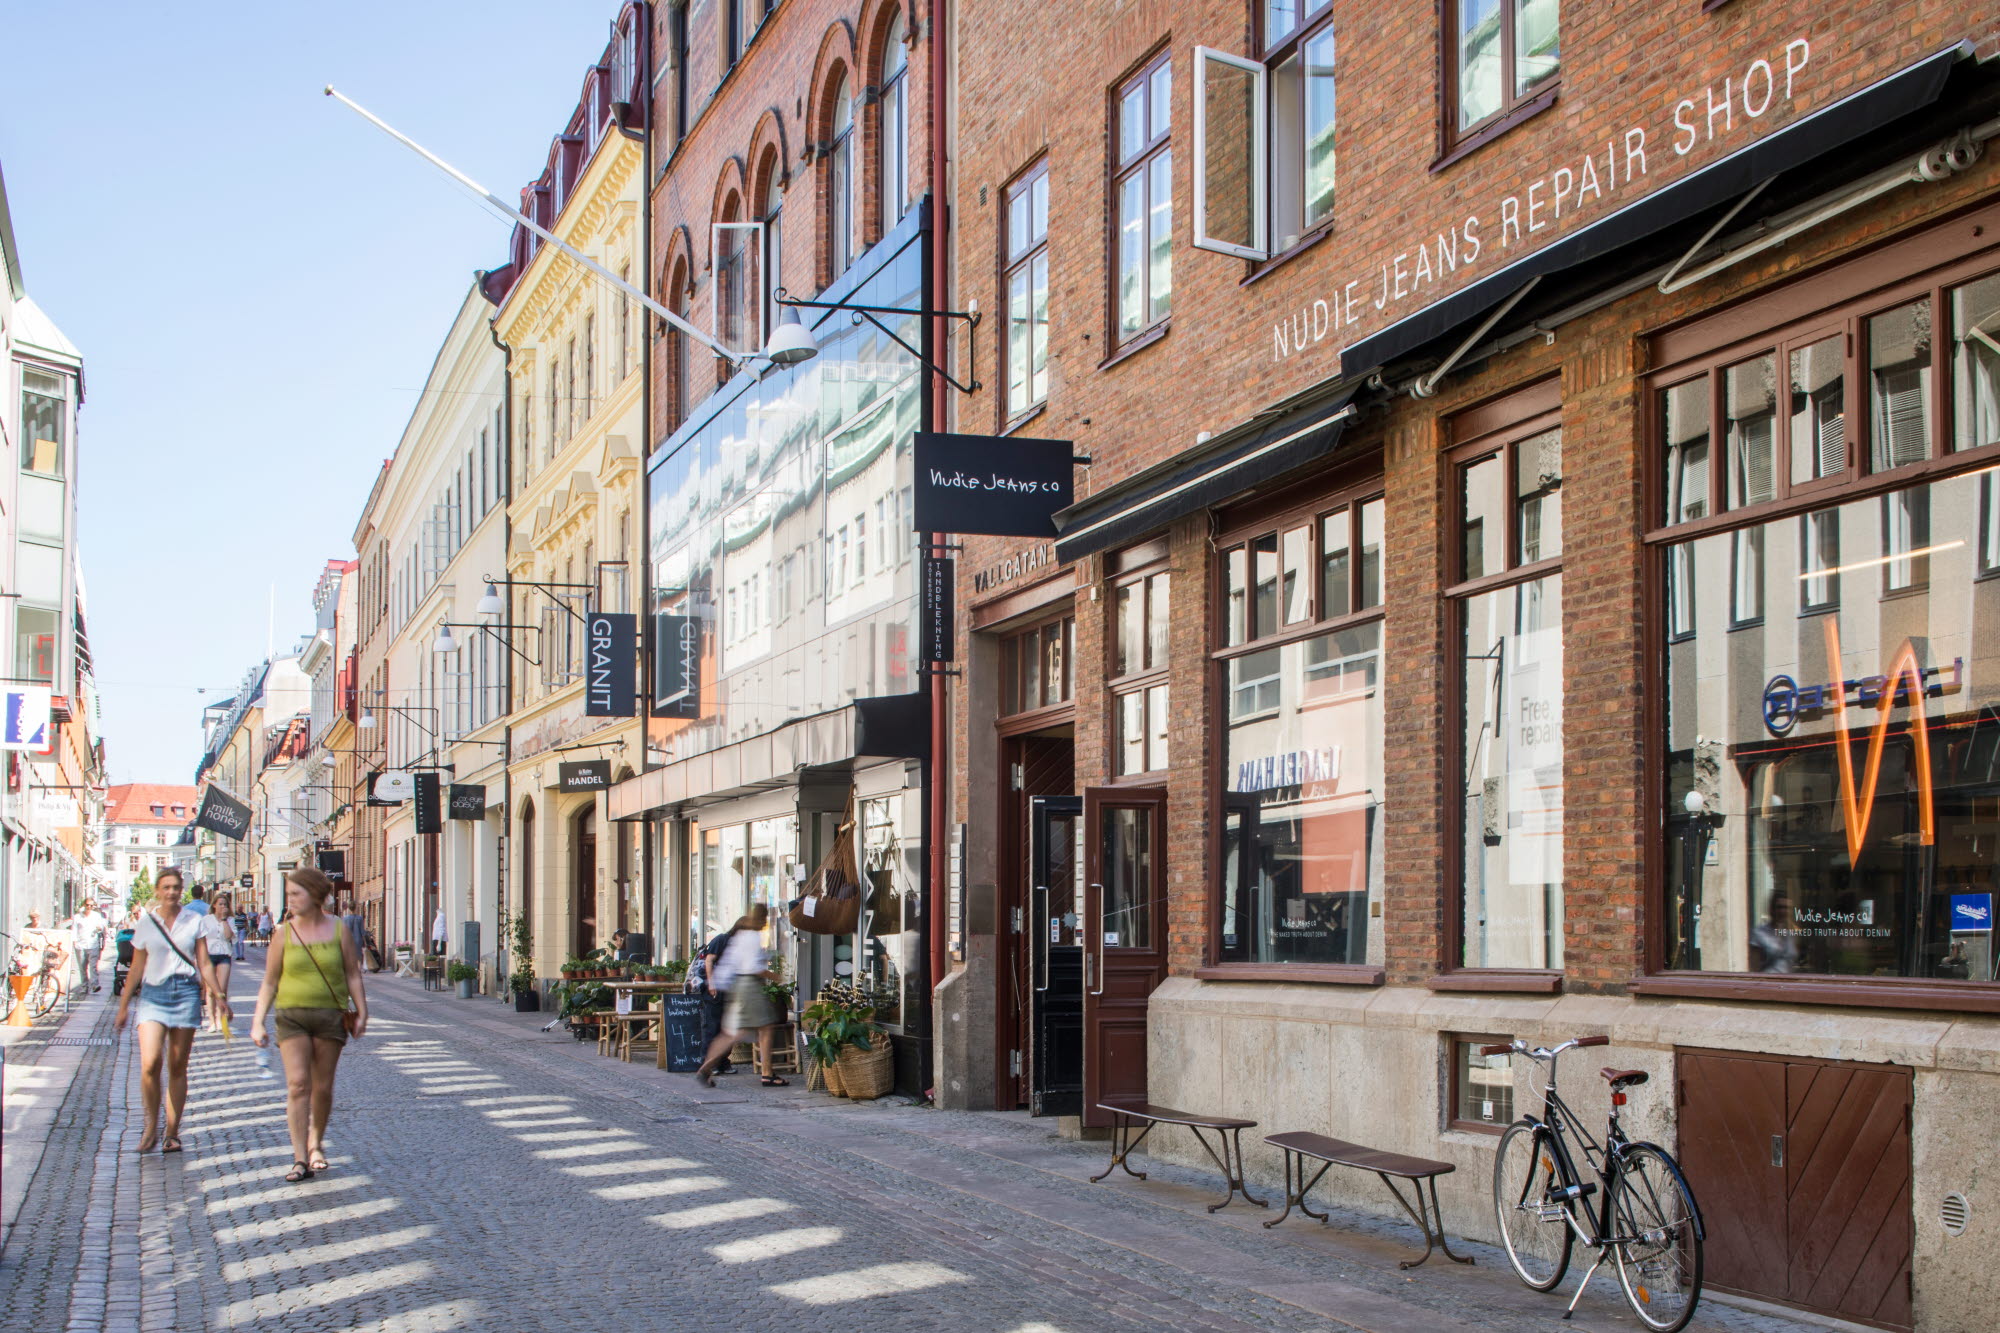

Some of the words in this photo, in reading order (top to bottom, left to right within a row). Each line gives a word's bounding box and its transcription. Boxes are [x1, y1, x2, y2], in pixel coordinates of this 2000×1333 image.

[1273, 279, 1359, 363] NUDIE
[1375, 215, 1481, 310] JEANS
[1501, 127, 1647, 248] REPAIR
[1673, 38, 1810, 156] SHOP
[930, 468, 980, 490] Nudie
[974, 543, 1048, 594] VALLGATAN
[591, 618, 612, 711] GRANIT
[567, 775, 604, 786] HANDEL
[205, 807, 242, 830] honey
[211, 804, 235, 818] milk
[1793, 906, 1822, 923] Nudie
[1774, 928, 1788, 937] THE
[1789, 928, 1812, 937] NAKED
[1814, 928, 1837, 937] TRUTH
[1839, 928, 1864, 937] ABOUT
[1866, 928, 1891, 937] DENIM
[671, 1023, 685, 1048] 4
